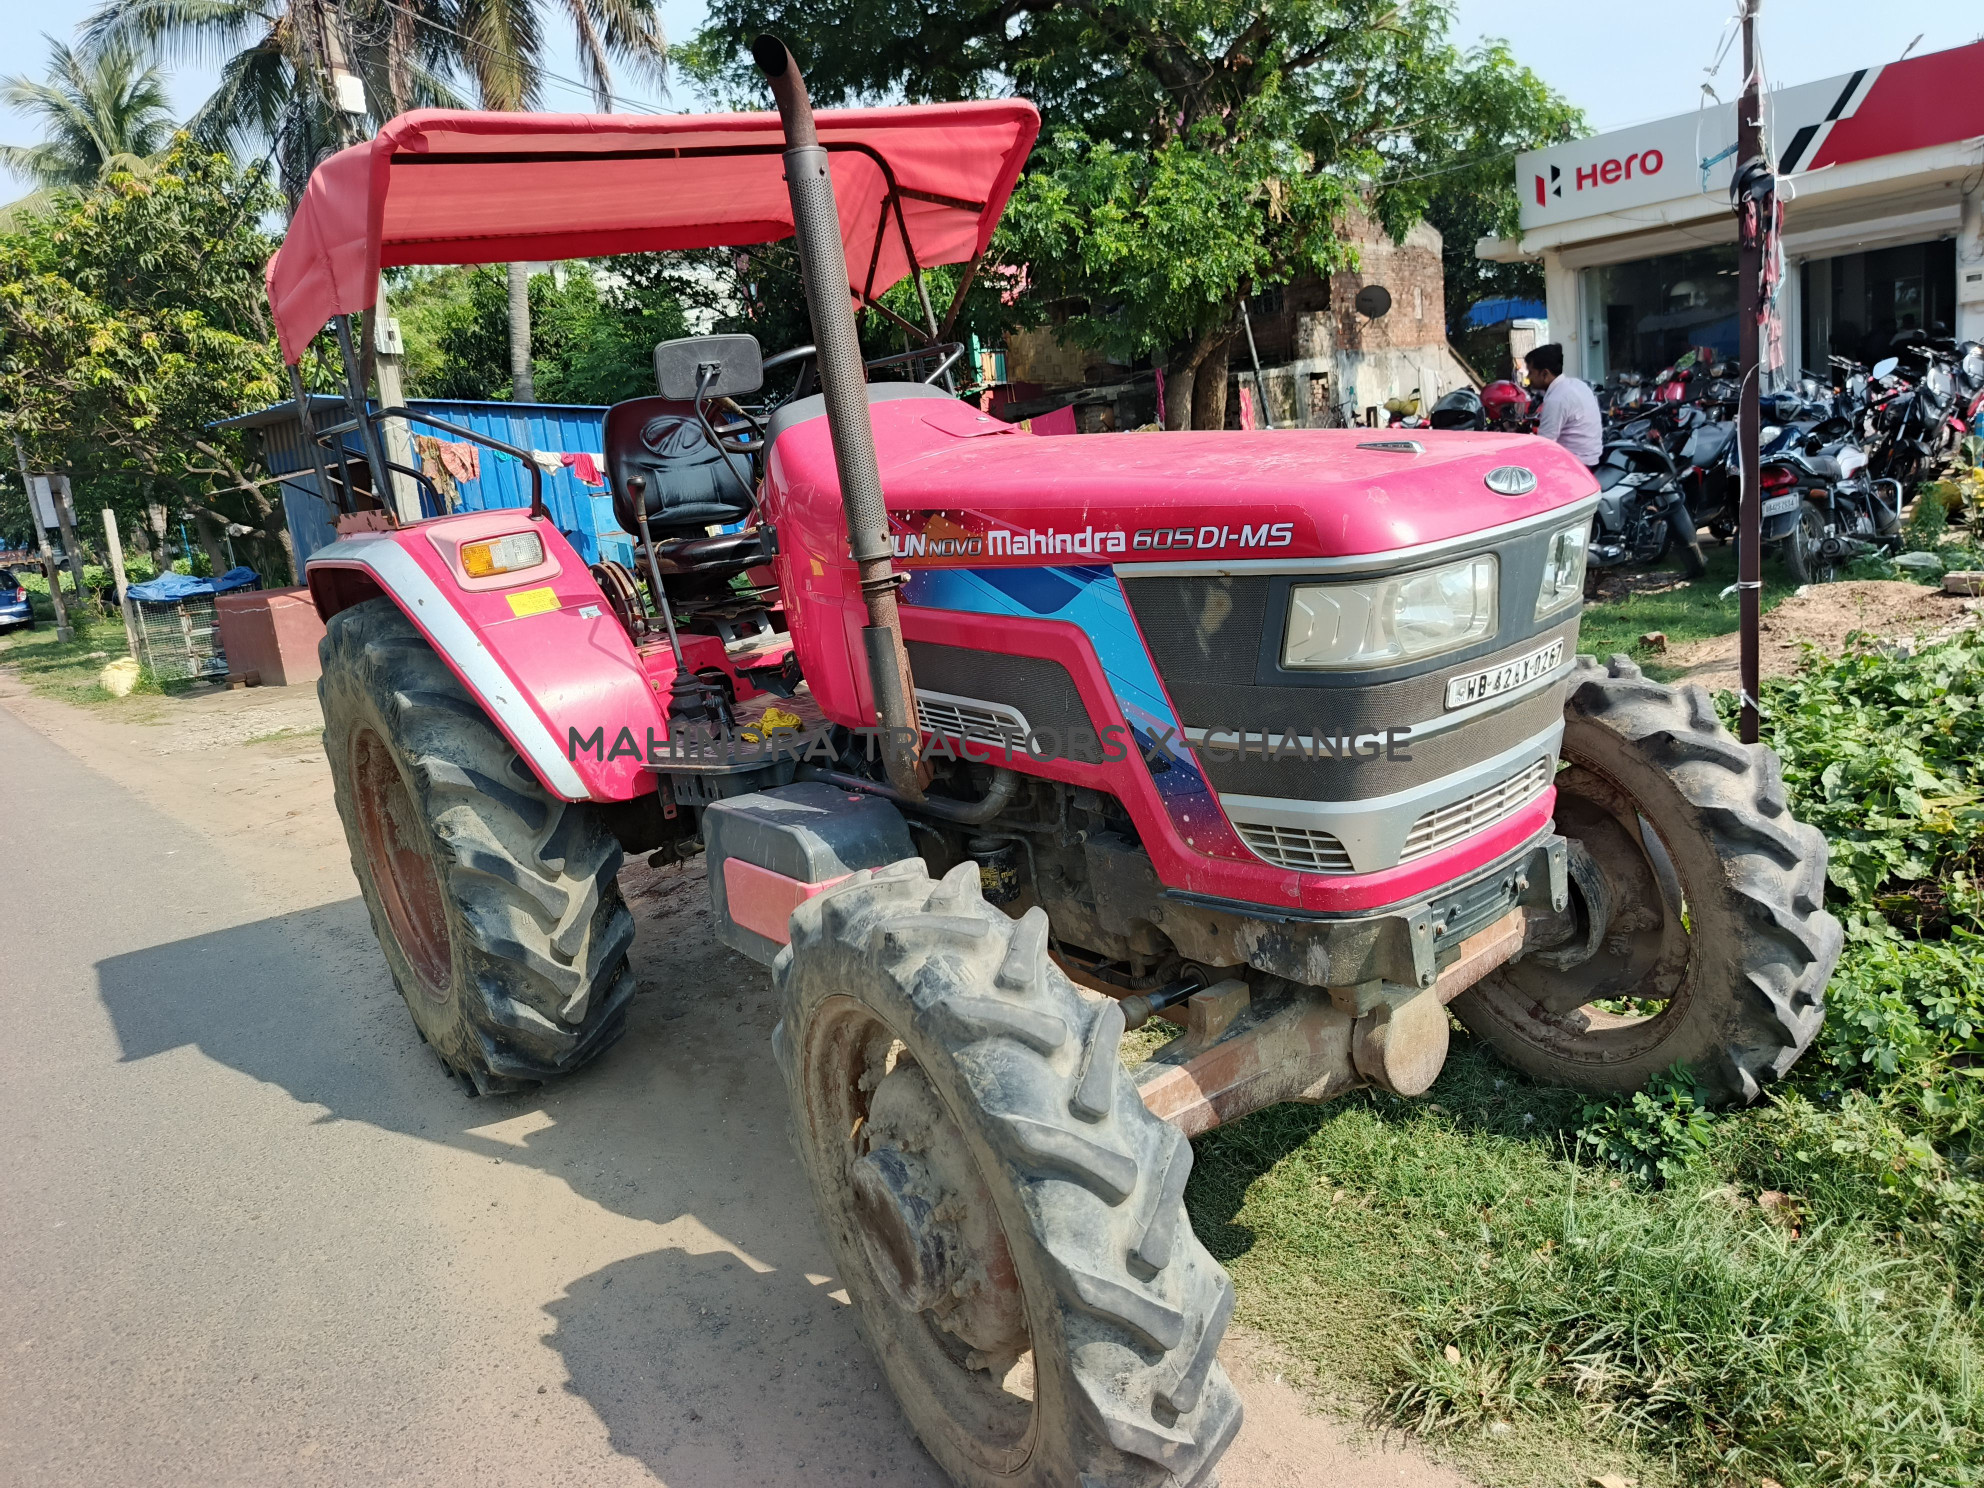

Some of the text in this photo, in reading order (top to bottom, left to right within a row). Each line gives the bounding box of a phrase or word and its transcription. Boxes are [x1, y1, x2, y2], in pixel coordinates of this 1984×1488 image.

[1575, 149, 1664, 192] Hero
[928, 538, 982, 557] NOVO
[987, 525, 1126, 556] Mahindra
